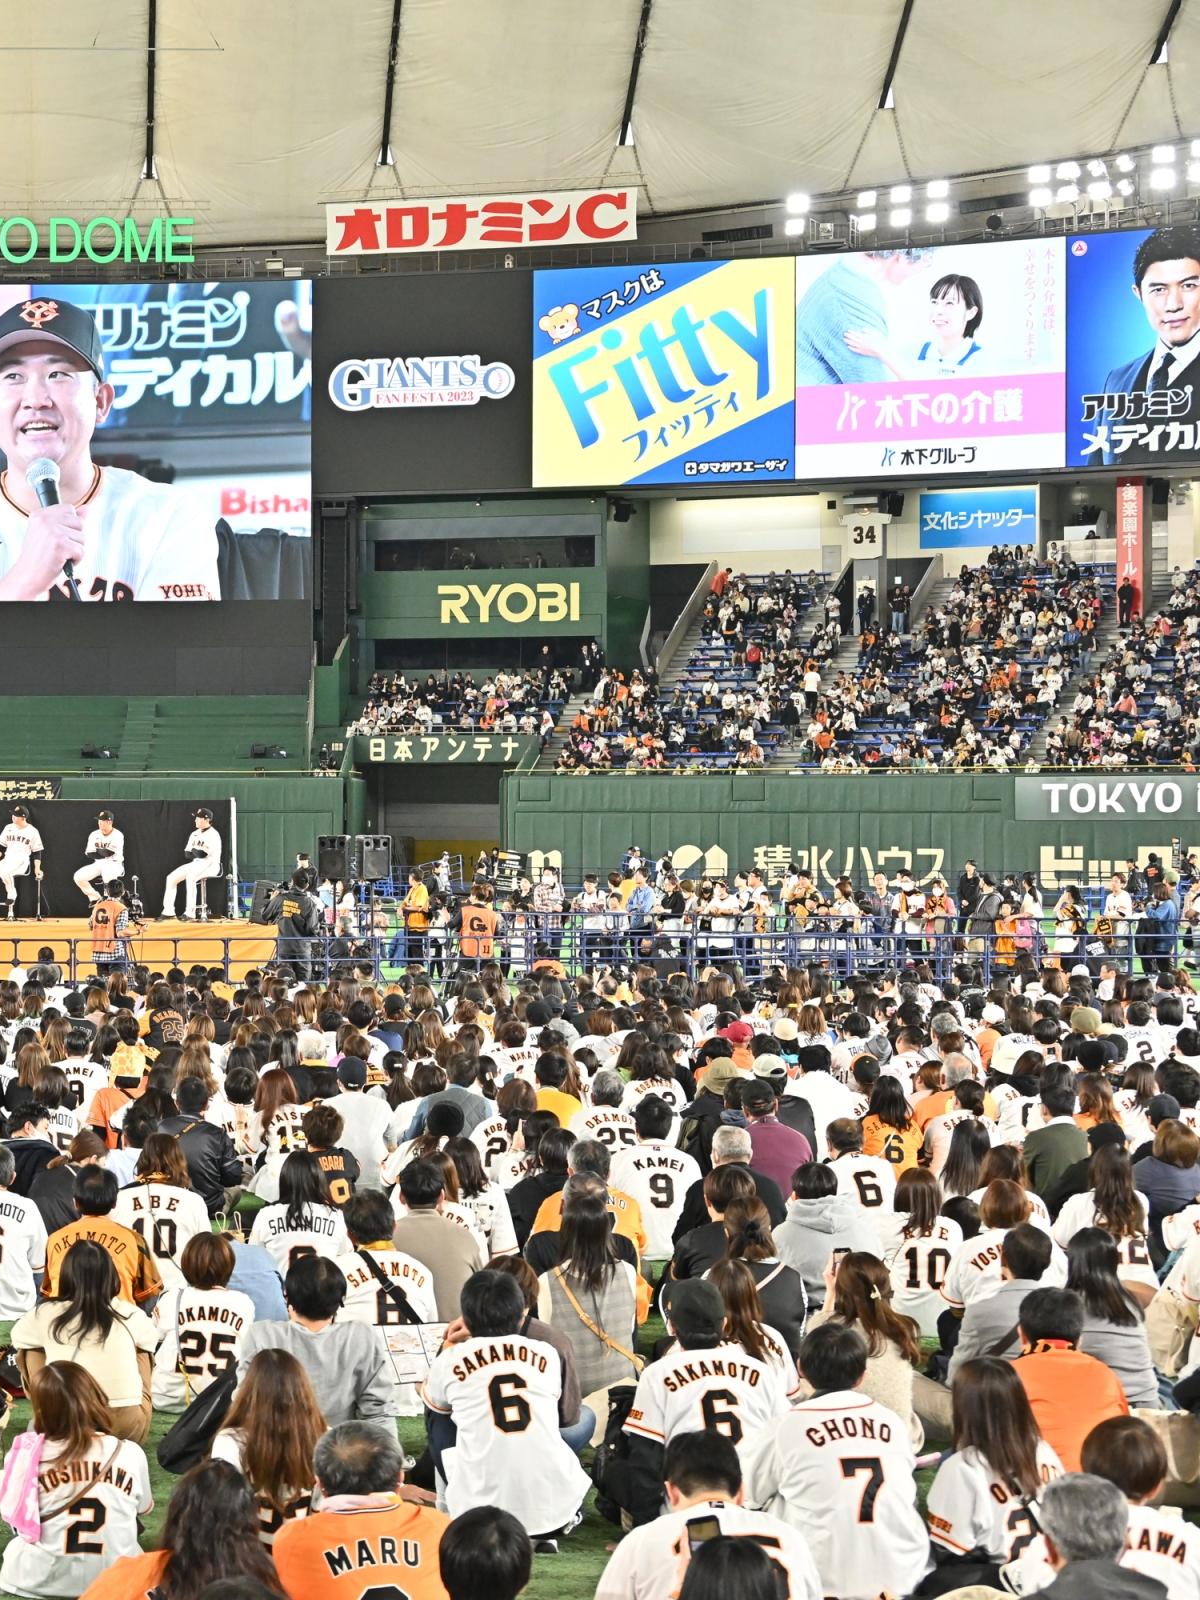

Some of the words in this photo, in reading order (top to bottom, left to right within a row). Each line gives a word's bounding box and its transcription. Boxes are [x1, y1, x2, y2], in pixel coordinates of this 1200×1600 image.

[50, 217, 195, 264] DOME
[335, 192, 629, 251] オロナミンC
[581, 268, 666, 320] マスクは
[78, 290, 250, 352] リナミン
[332, 357, 478, 409] GIANTS
[548, 288, 773, 450] Fitty
[375, 391, 400, 405] FAN
[402, 391, 444, 404] FESTA
[447, 390, 474, 403] 2023
[875, 387, 1024, 430] 木下の介護
[1081, 384, 1193, 421] アリナミン
[622, 391, 741, 463] フィッティ
[697, 459, 789, 474] タマガワエーザイ
[900, 446, 978, 466] 木下グループ
[853, 526, 877, 545] 34
[1121, 486, 1138, 577] 後楽園ホール
[437, 582, 580, 624] RYOBI
[369, 737, 519, 762] 日本アンテナ
[1041, 782, 1183, 814] TOKYO
[753, 844, 949, 888] 積水ハウス
[1136, 1040, 1156, 1063] 2
[63, 1067, 94, 1079] AMEI
[585, 1114, 636, 1130] OKAMOT
[632, 1158, 685, 1173] KAMEI
[132, 1194, 179, 1213] ABE
[649, 1173, 675, 1209] 9
[853, 1169, 883, 1208] 6
[131, 1217, 177, 1259] 10
[905, 1246, 952, 1290] 10
[177, 1329, 239, 1376] 25
[452, 1344, 548, 1382] SAKAMOTO
[663, 1359, 761, 1393] SAKAMOTO
[487, 1372, 532, 1434] 6
[700, 1388, 744, 1446] 6
[805, 1416, 892, 1448] CHONO
[838, 1456, 885, 1524] 7
[64, 1497, 107, 1555] 2
[323, 1536, 422, 1577] MARU
